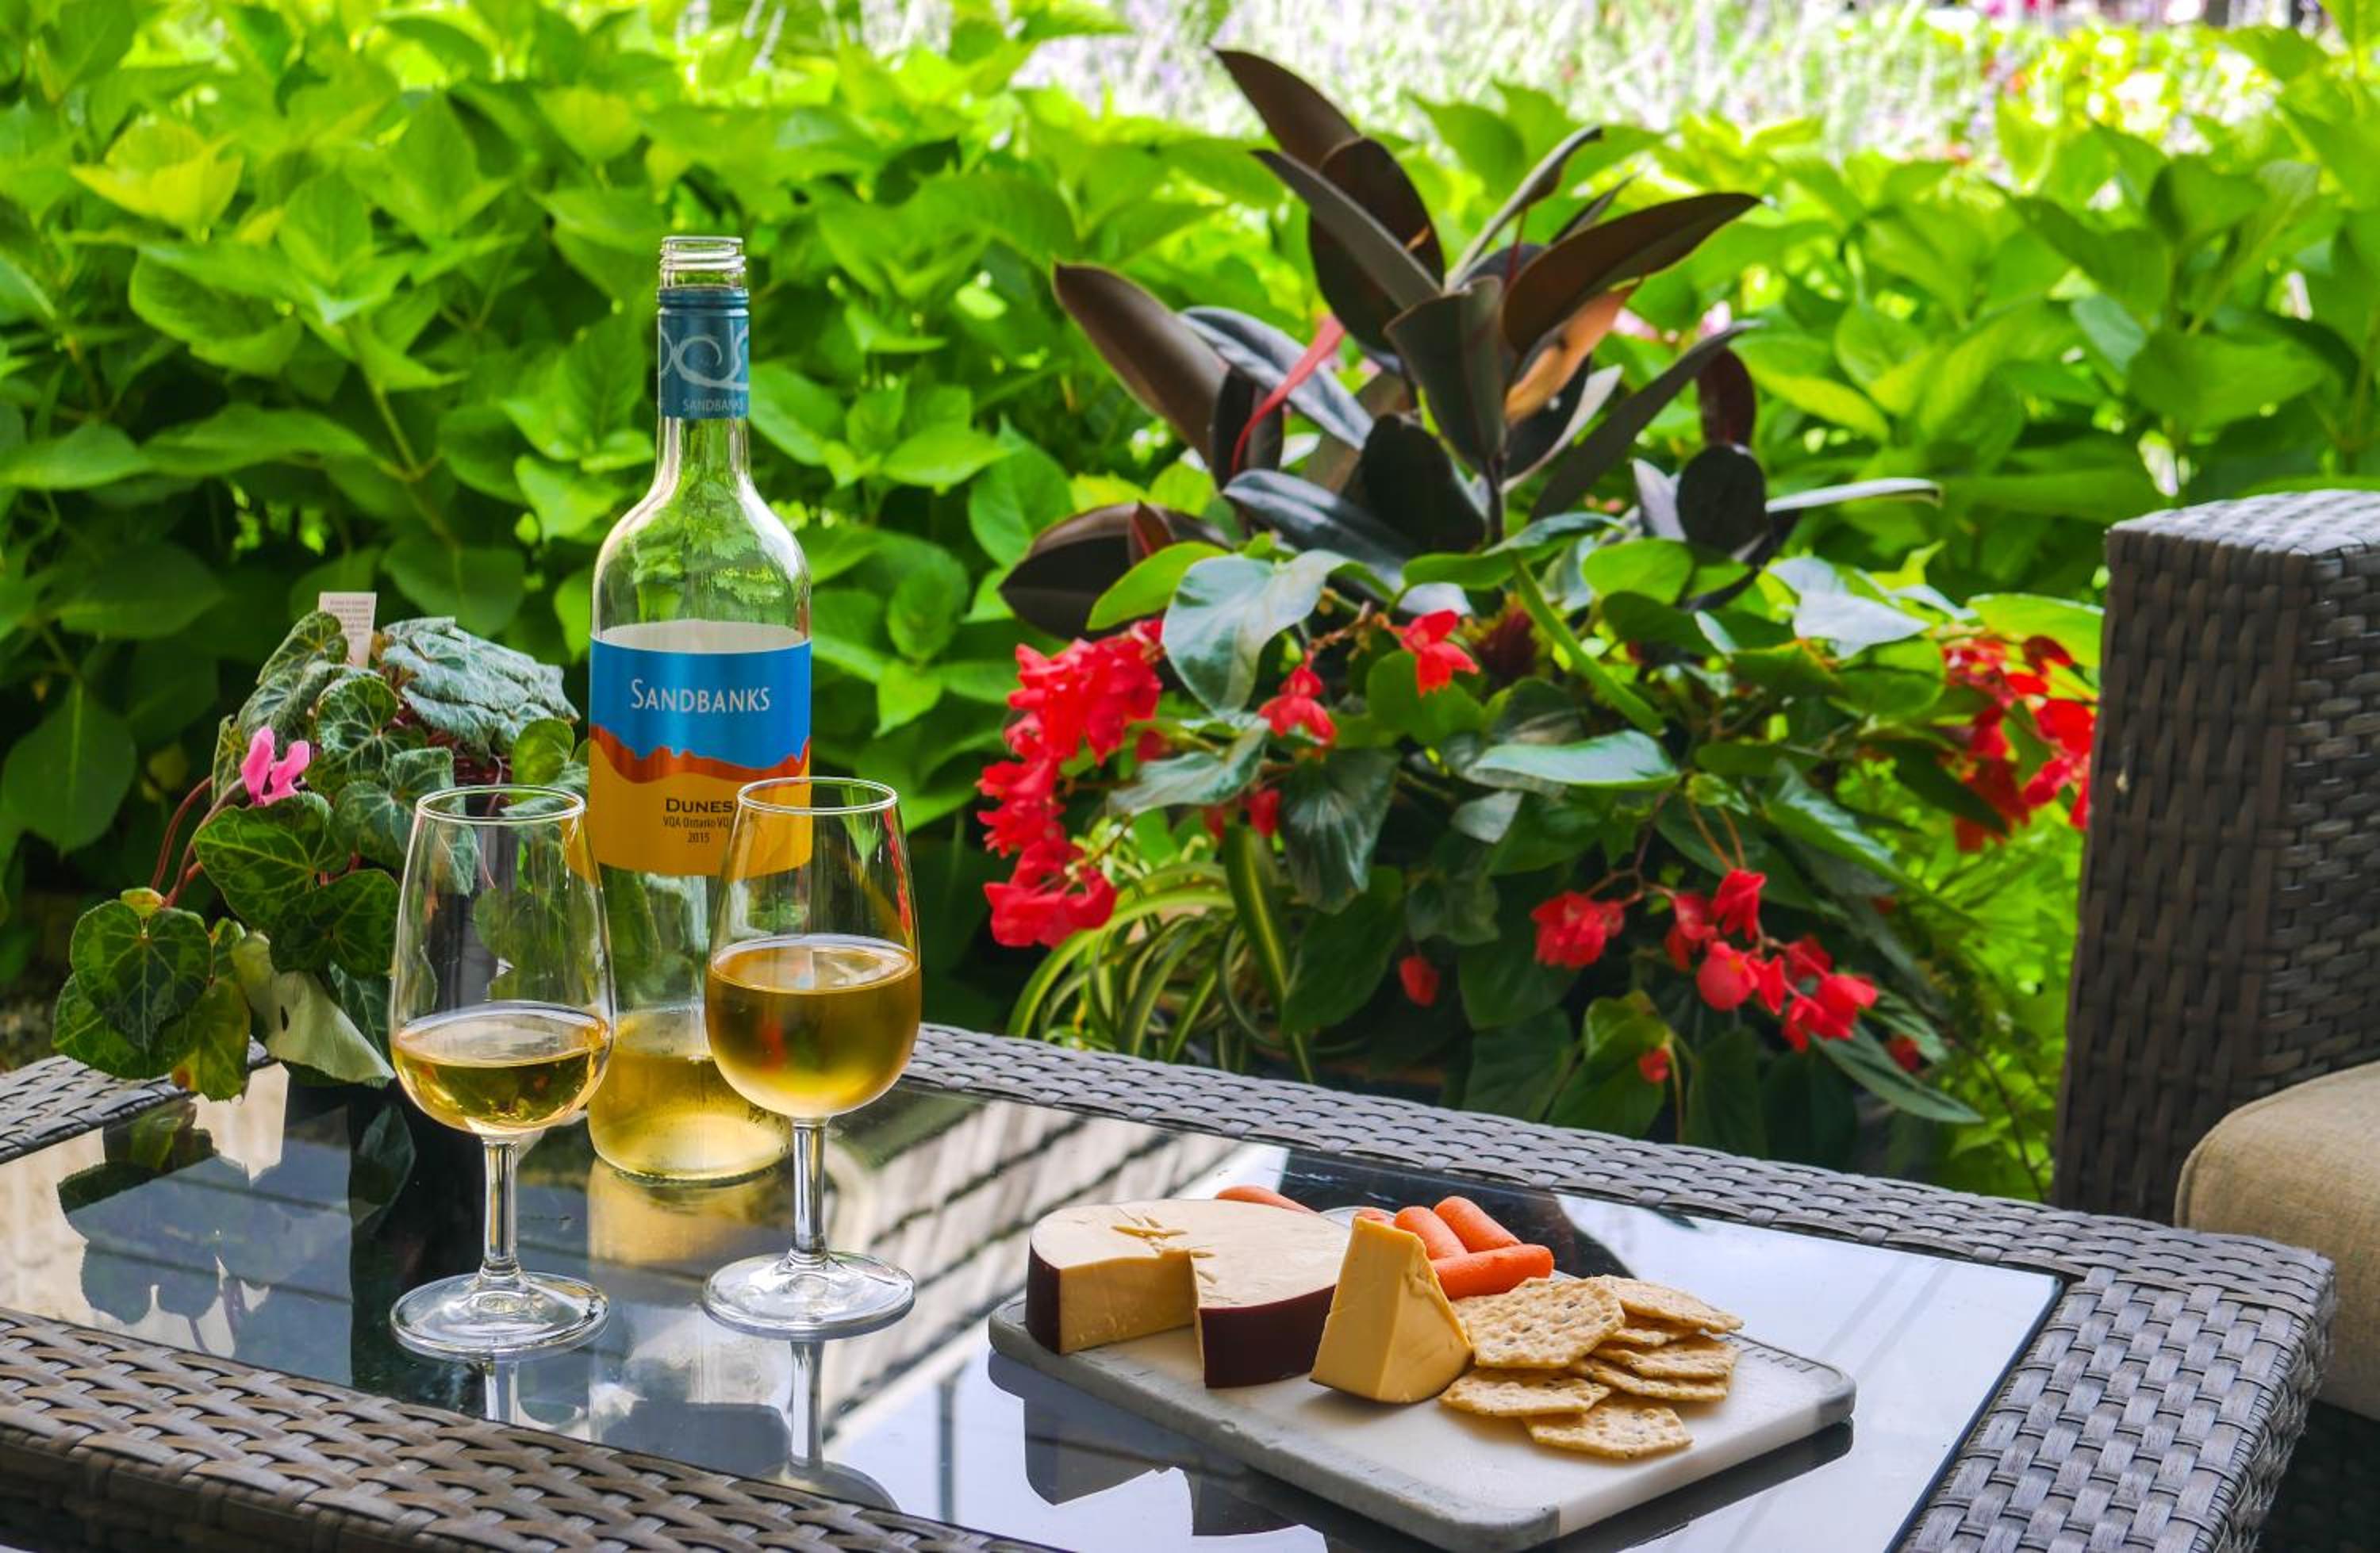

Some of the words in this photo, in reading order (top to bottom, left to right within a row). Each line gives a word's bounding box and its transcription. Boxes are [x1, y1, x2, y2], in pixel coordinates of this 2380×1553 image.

[631, 678, 771, 713] SANDBANKS
[665, 798, 734, 813] DUNES
[683, 816, 716, 829] Ontario
[687, 832, 710, 843] 2015
